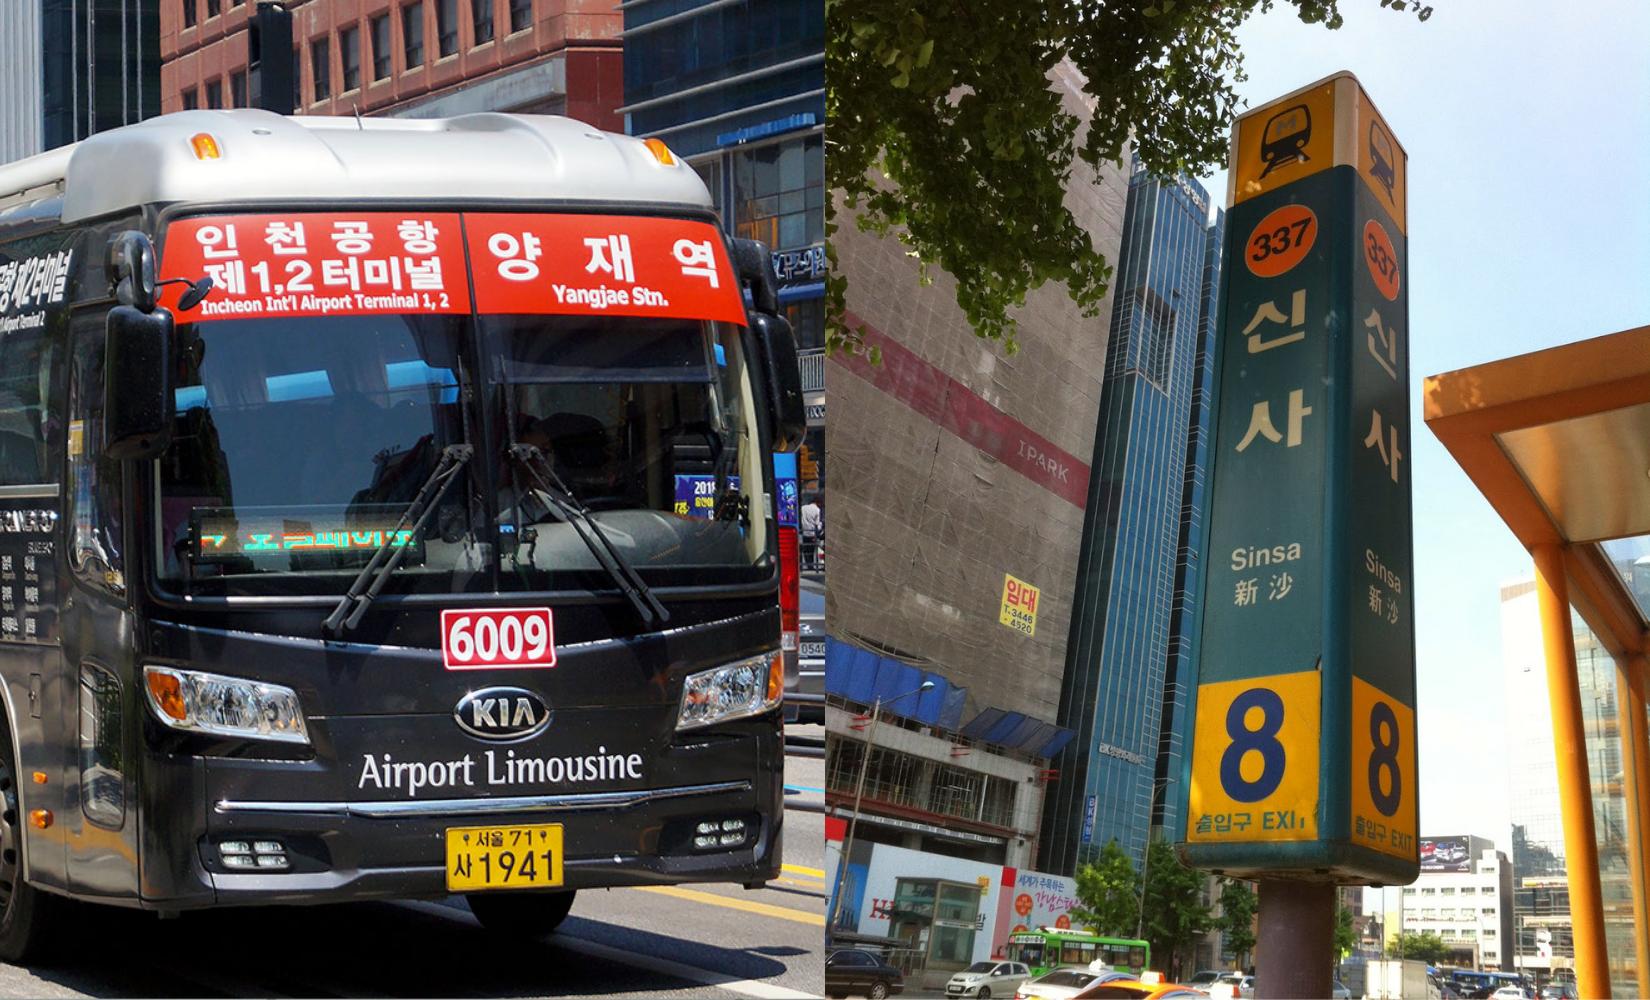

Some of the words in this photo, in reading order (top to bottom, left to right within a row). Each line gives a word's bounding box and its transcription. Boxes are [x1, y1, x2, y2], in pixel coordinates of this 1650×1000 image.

[1252, 217, 1312, 262] 337
[1367, 241, 1398, 285] 337
[201, 297, 262, 315] Incheon
[265, 295, 297, 312] Int'l
[300, 294, 352, 313] Airport
[354, 292, 419, 309] Terminal
[423, 292, 436, 310] 1,
[438, 292, 450, 308] 2
[553, 284, 628, 309] Yangjae
[632, 286, 669, 306] Stn.
[1017, 440, 1069, 484] IPARK
[1231, 542, 1302, 572] Sinsa
[1365, 549, 1402, 594] Sinsa
[1007, 580, 1037, 613] 임대
[449, 615, 549, 662] 6009
[471, 697, 536, 728] KIA
[1220, 687, 1286, 803] 8
[1368, 701, 1402, 817] 8
[358, 752, 475, 796] Airport
[485, 746, 643, 785] Limousine
[475, 830, 504, 847] 서울
[1195, 813, 1252, 833] 출입구
[1356, 815, 1387, 843] 출입구
[1392, 829, 1413, 851] EXIT
